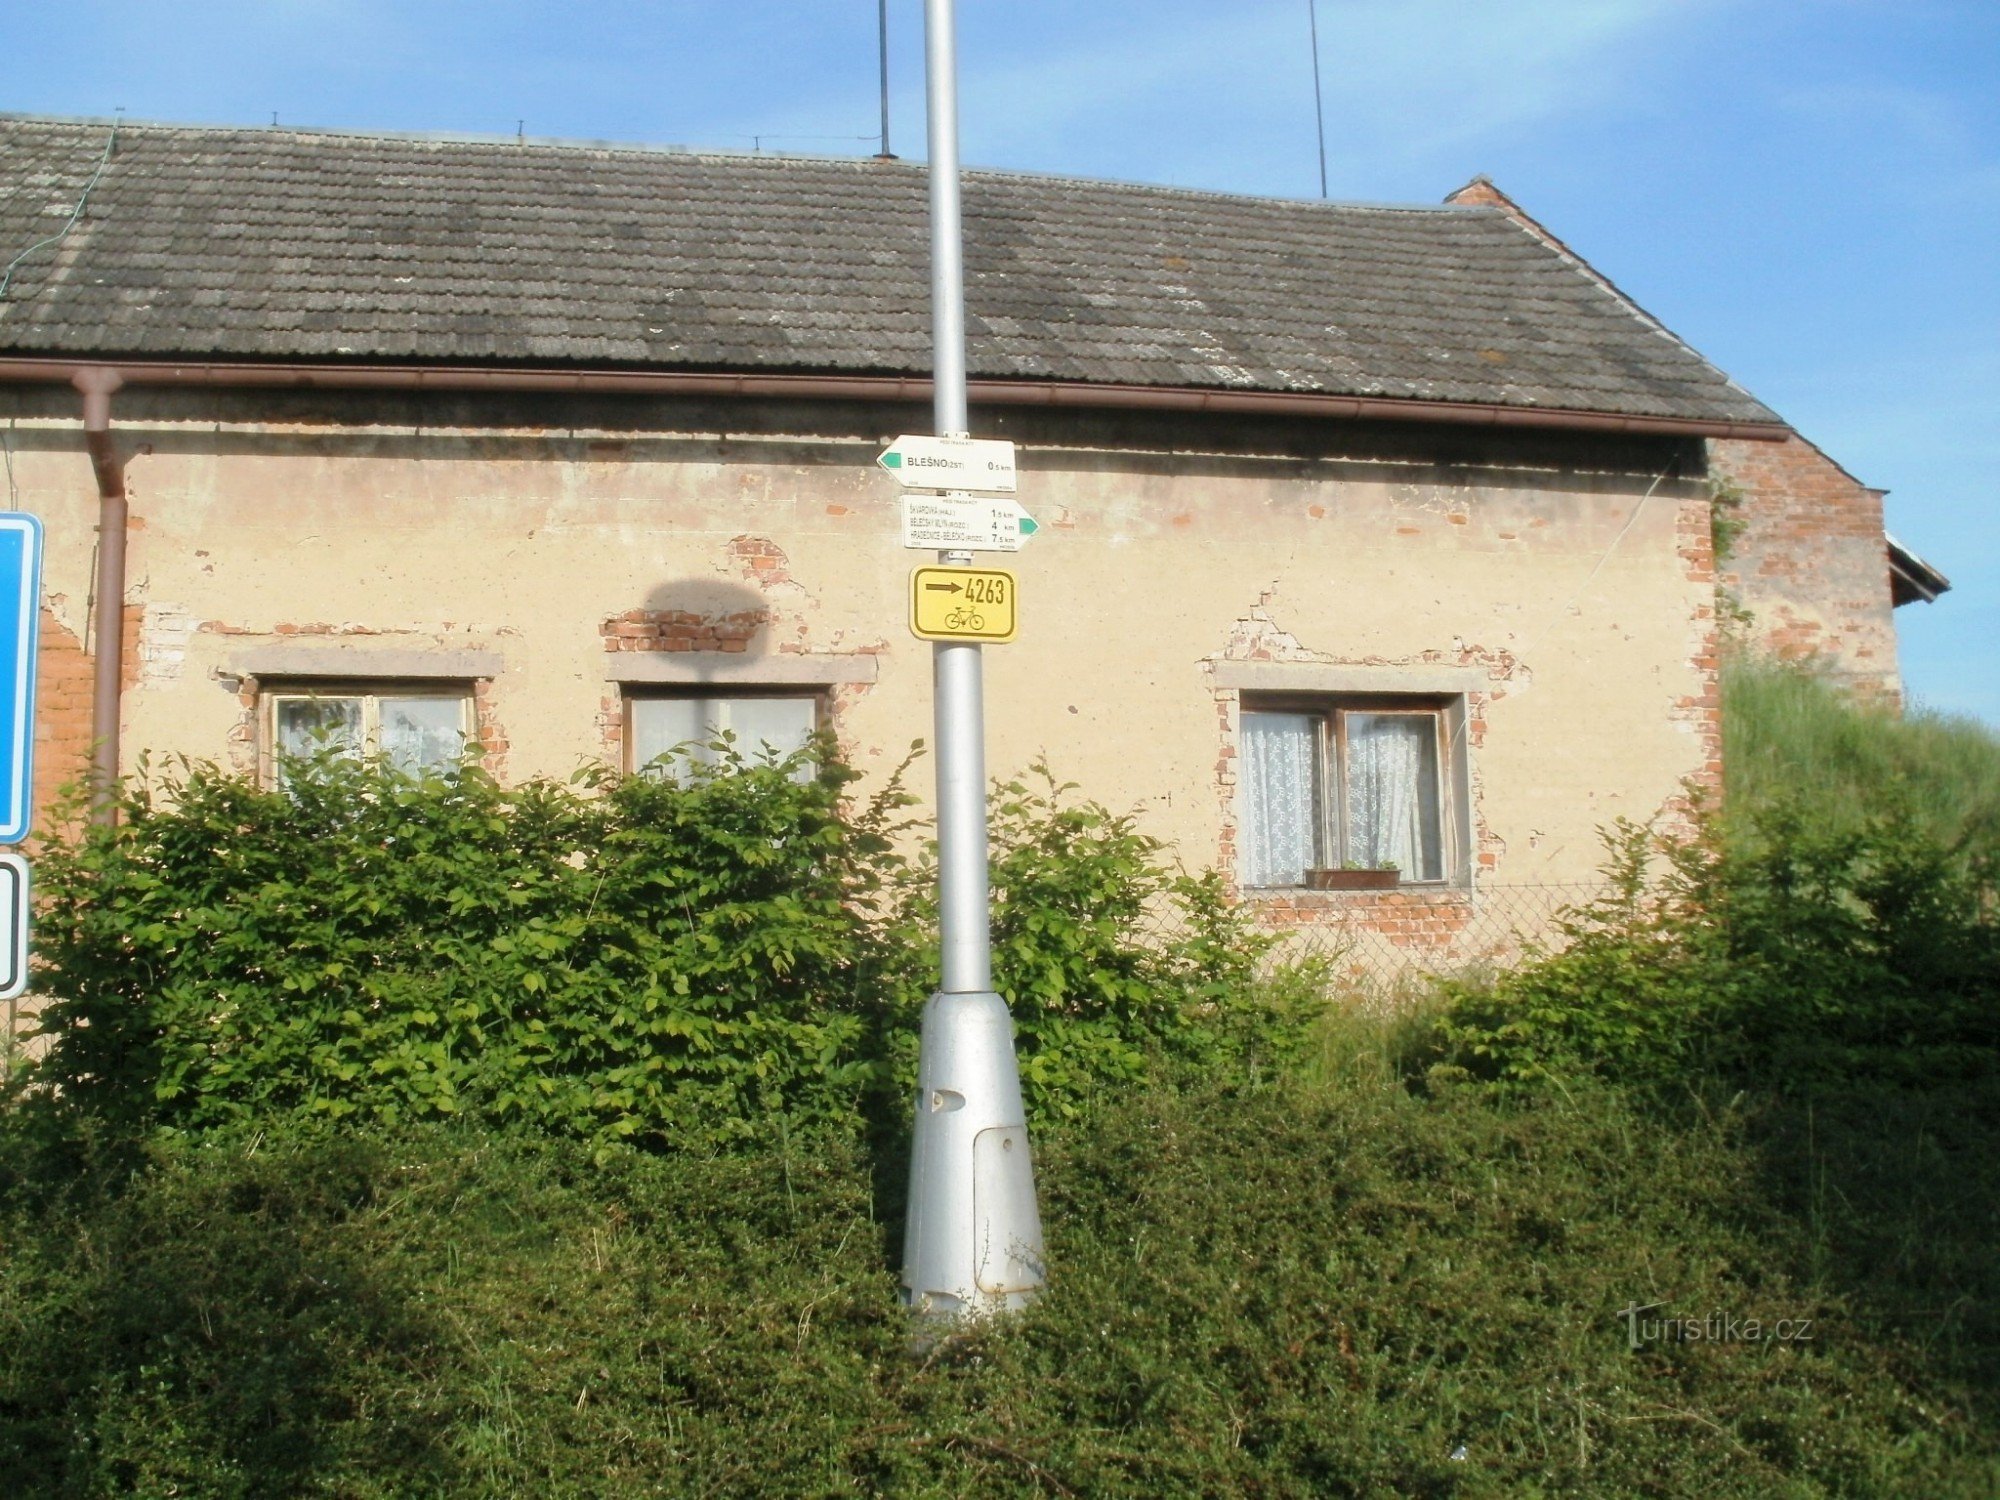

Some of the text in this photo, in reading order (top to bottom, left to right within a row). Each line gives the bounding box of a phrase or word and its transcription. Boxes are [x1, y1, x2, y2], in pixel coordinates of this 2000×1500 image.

[908, 456, 948, 468] BLEŠNO
[991, 521, 998, 530] 4
[965, 578, 1004, 605] 4263
